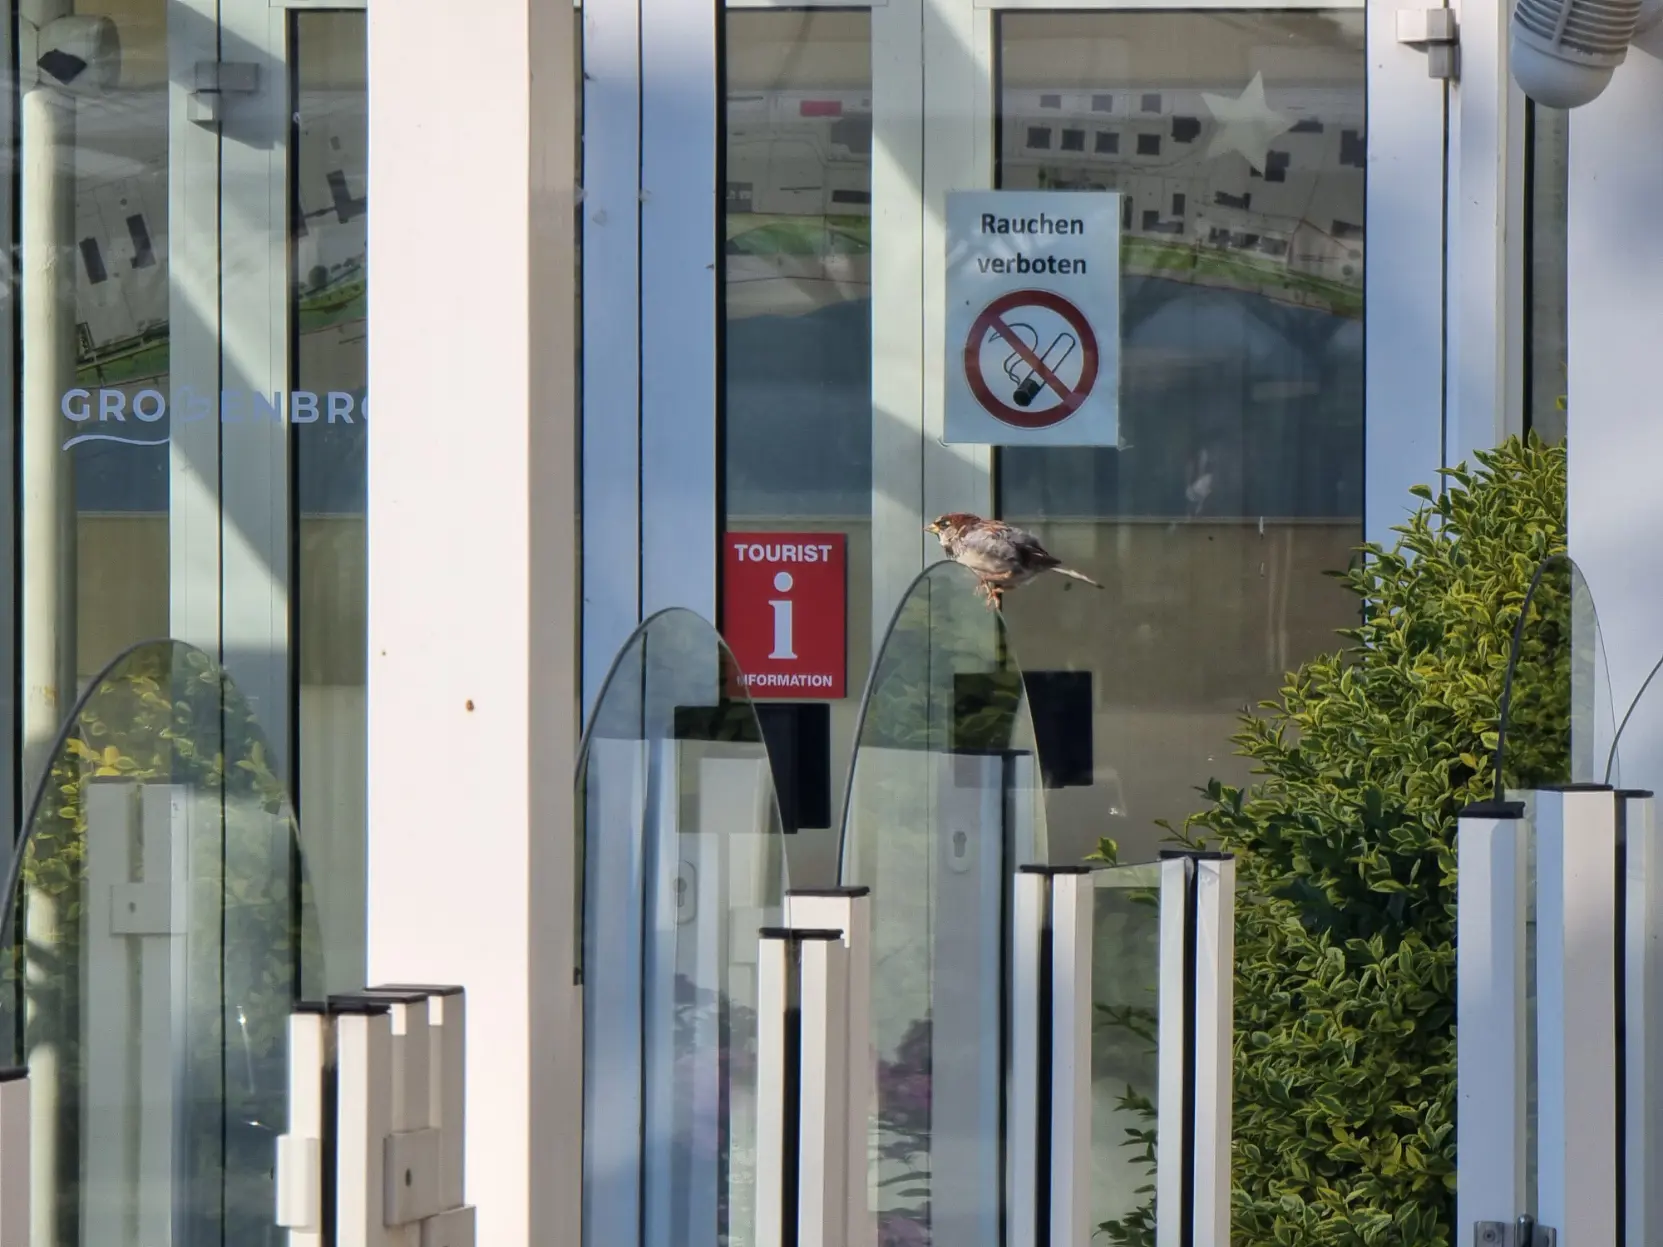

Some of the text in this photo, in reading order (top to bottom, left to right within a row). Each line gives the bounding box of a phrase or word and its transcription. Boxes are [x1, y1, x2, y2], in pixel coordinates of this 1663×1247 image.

[981, 213, 1084, 235] Rauchen
[977, 252, 1087, 274] verboten
[734, 544, 832, 562] TOURIST
